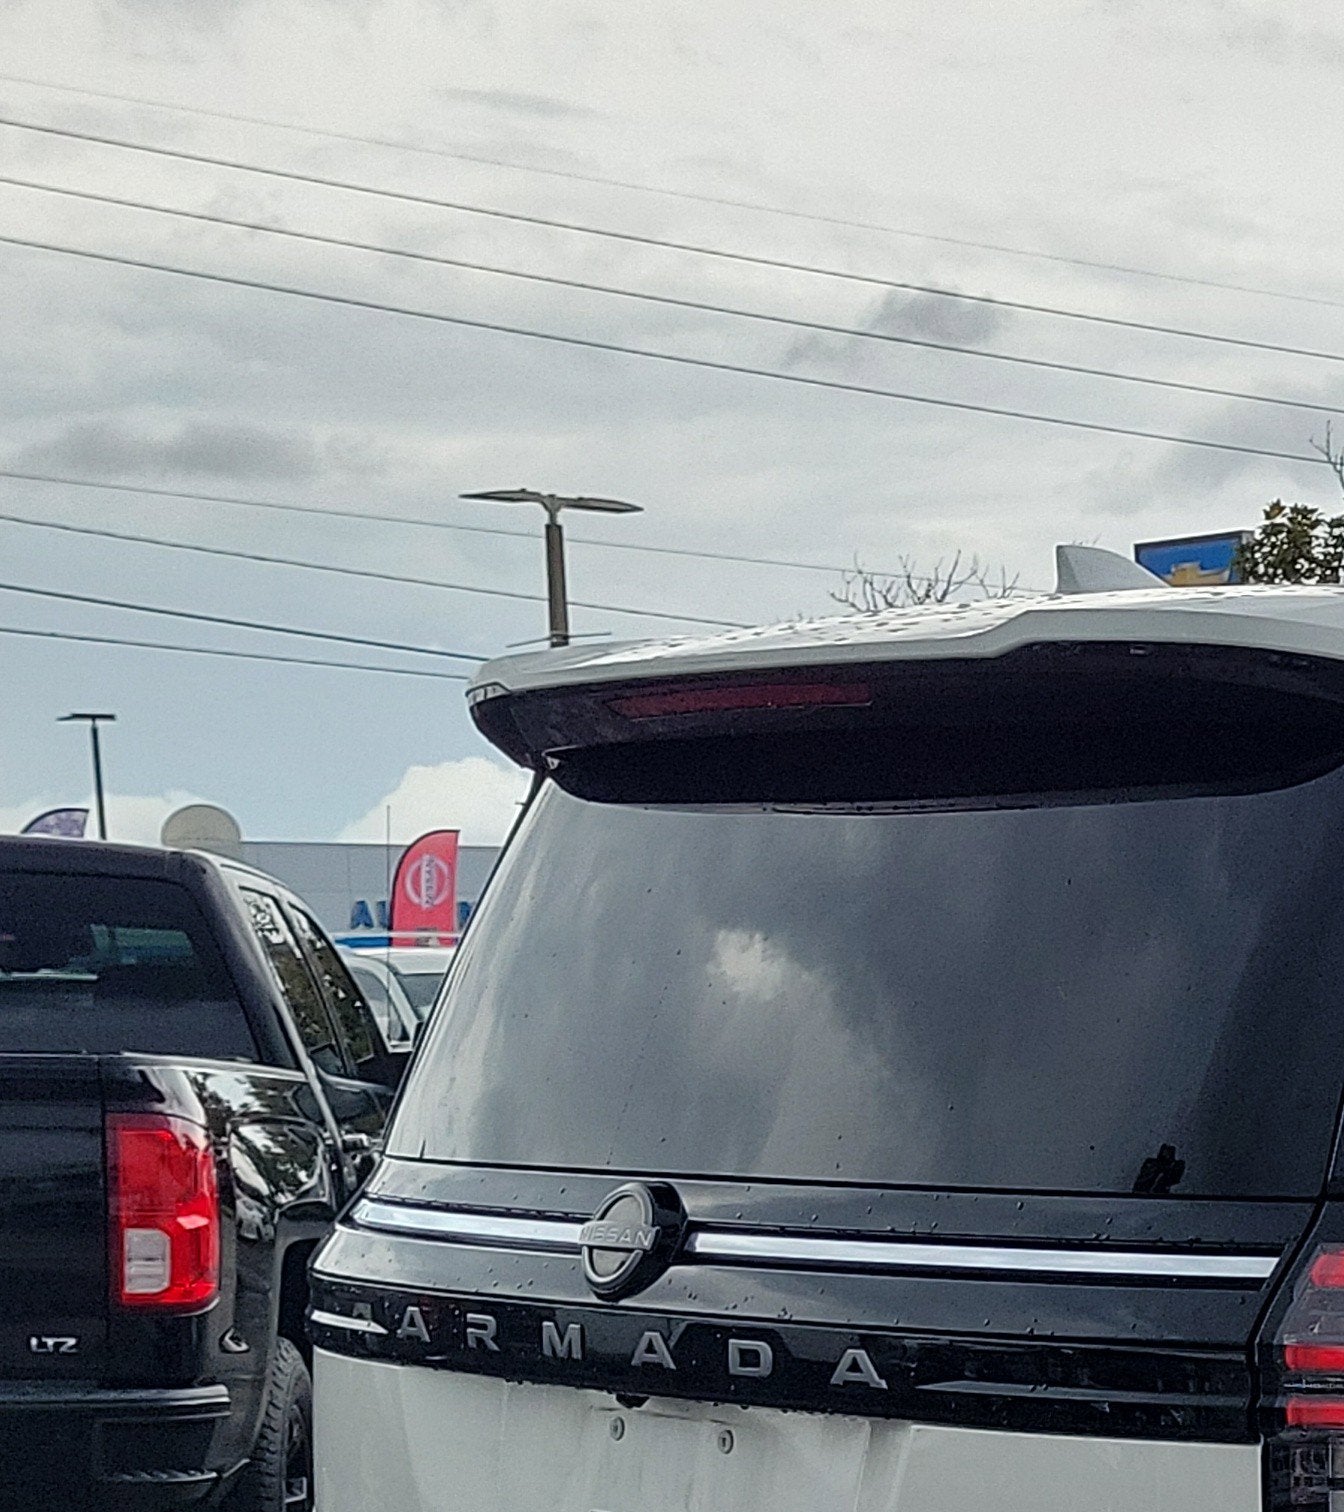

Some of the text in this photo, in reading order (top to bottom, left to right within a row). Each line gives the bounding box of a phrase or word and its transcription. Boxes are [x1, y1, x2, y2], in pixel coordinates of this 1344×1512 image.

[580, 1226, 657, 1248] NISSAN
[29, 1335, 80, 1353] LTZ
[396, 1306, 888, 1390] ARMADA
